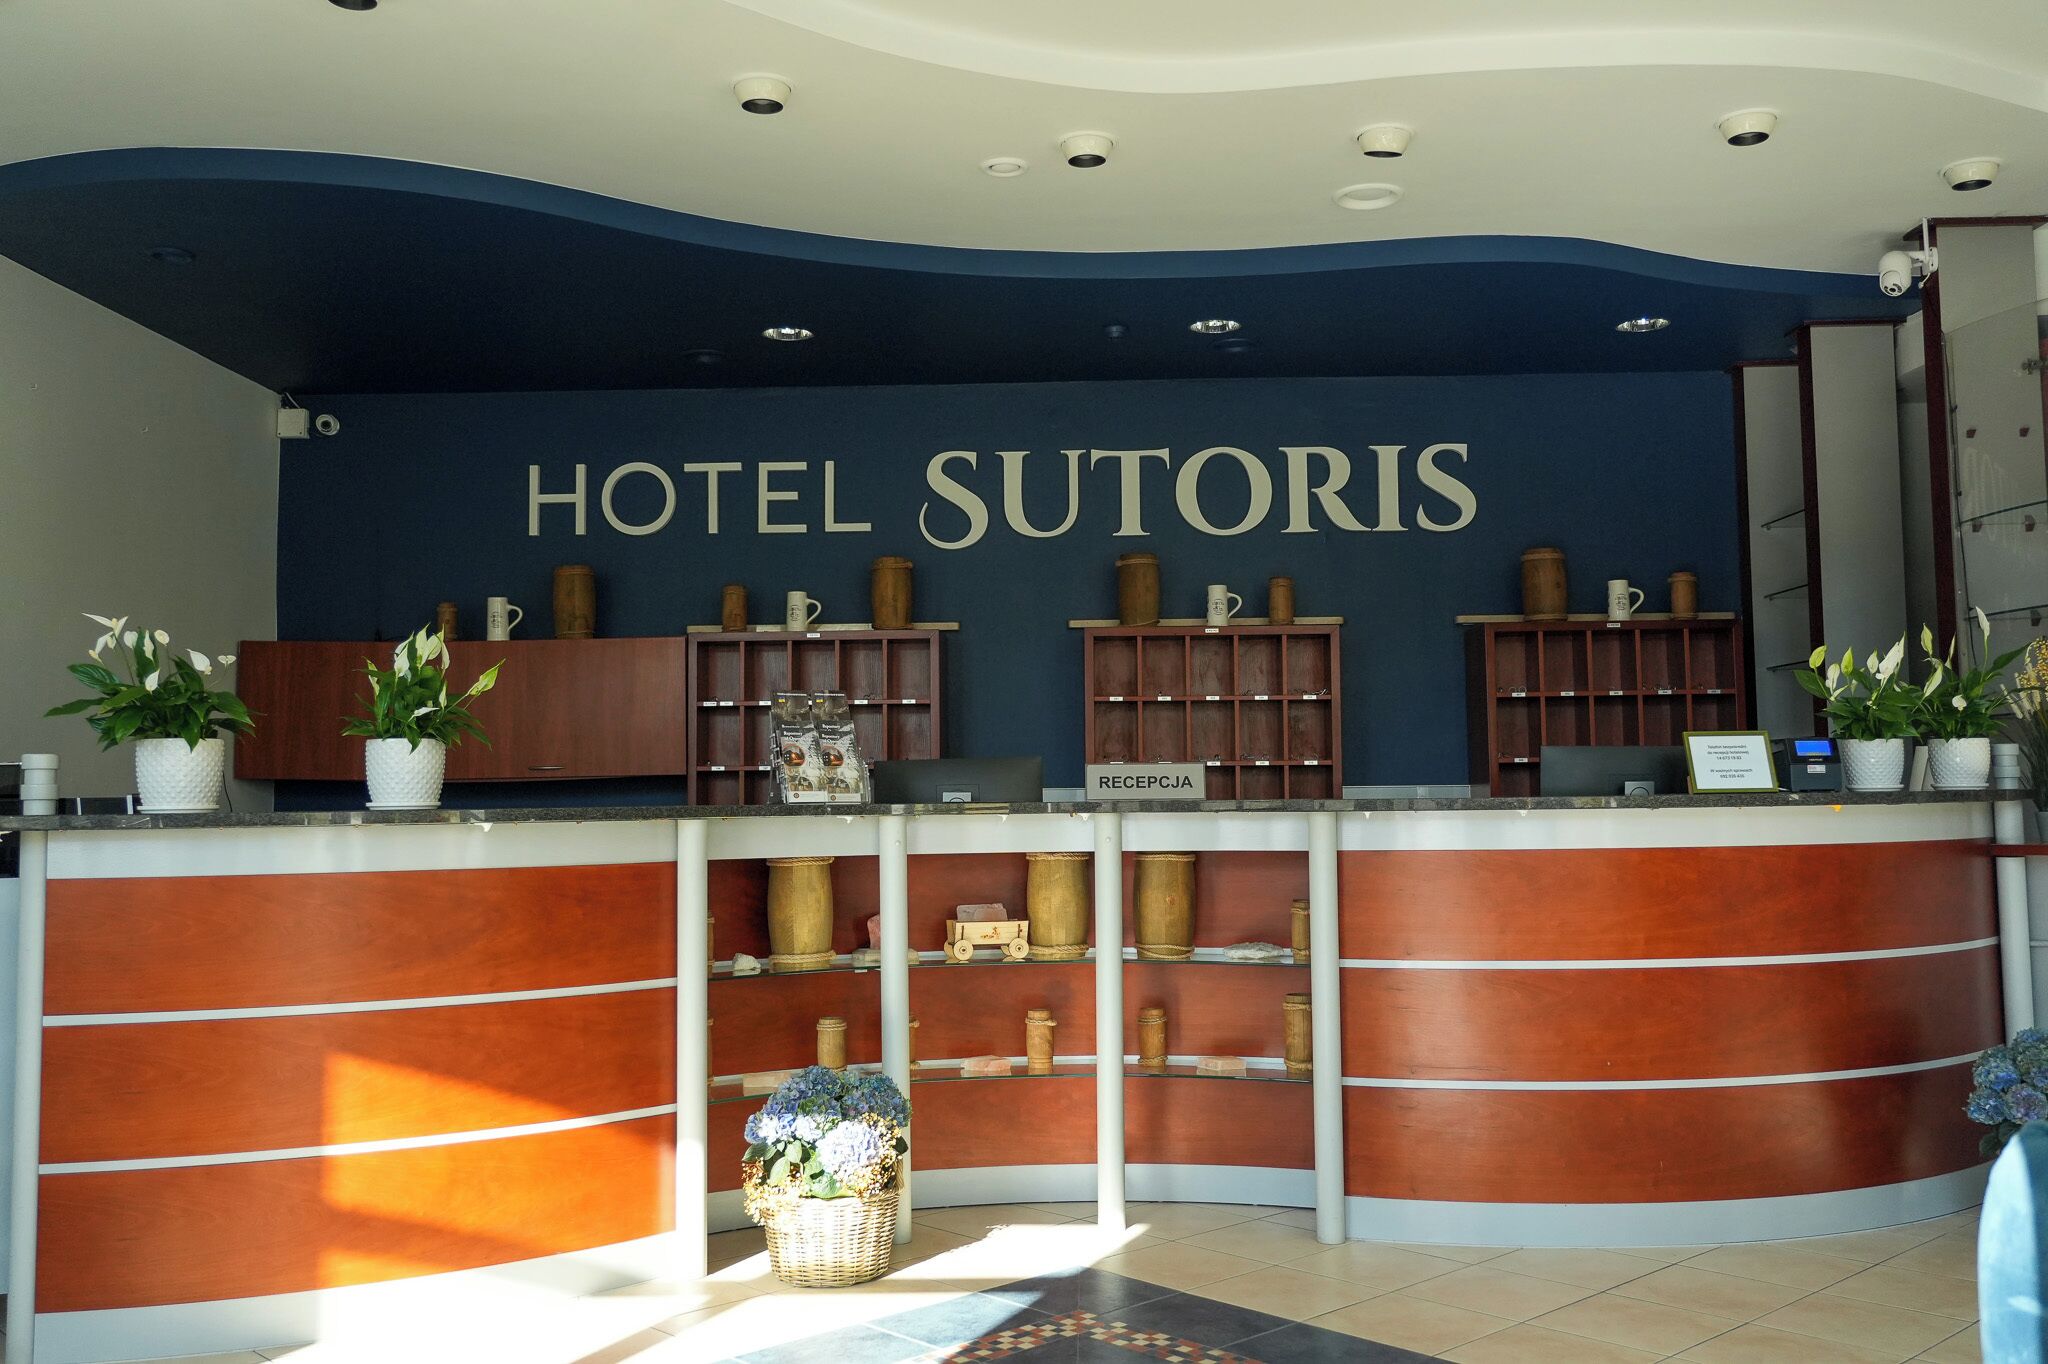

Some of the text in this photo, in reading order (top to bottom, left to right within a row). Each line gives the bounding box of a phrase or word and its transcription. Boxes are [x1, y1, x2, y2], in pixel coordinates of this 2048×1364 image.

[528, 443, 1477, 550] HOTEL SUTORIS
[1099, 775, 1194, 789] RECEPCJA
